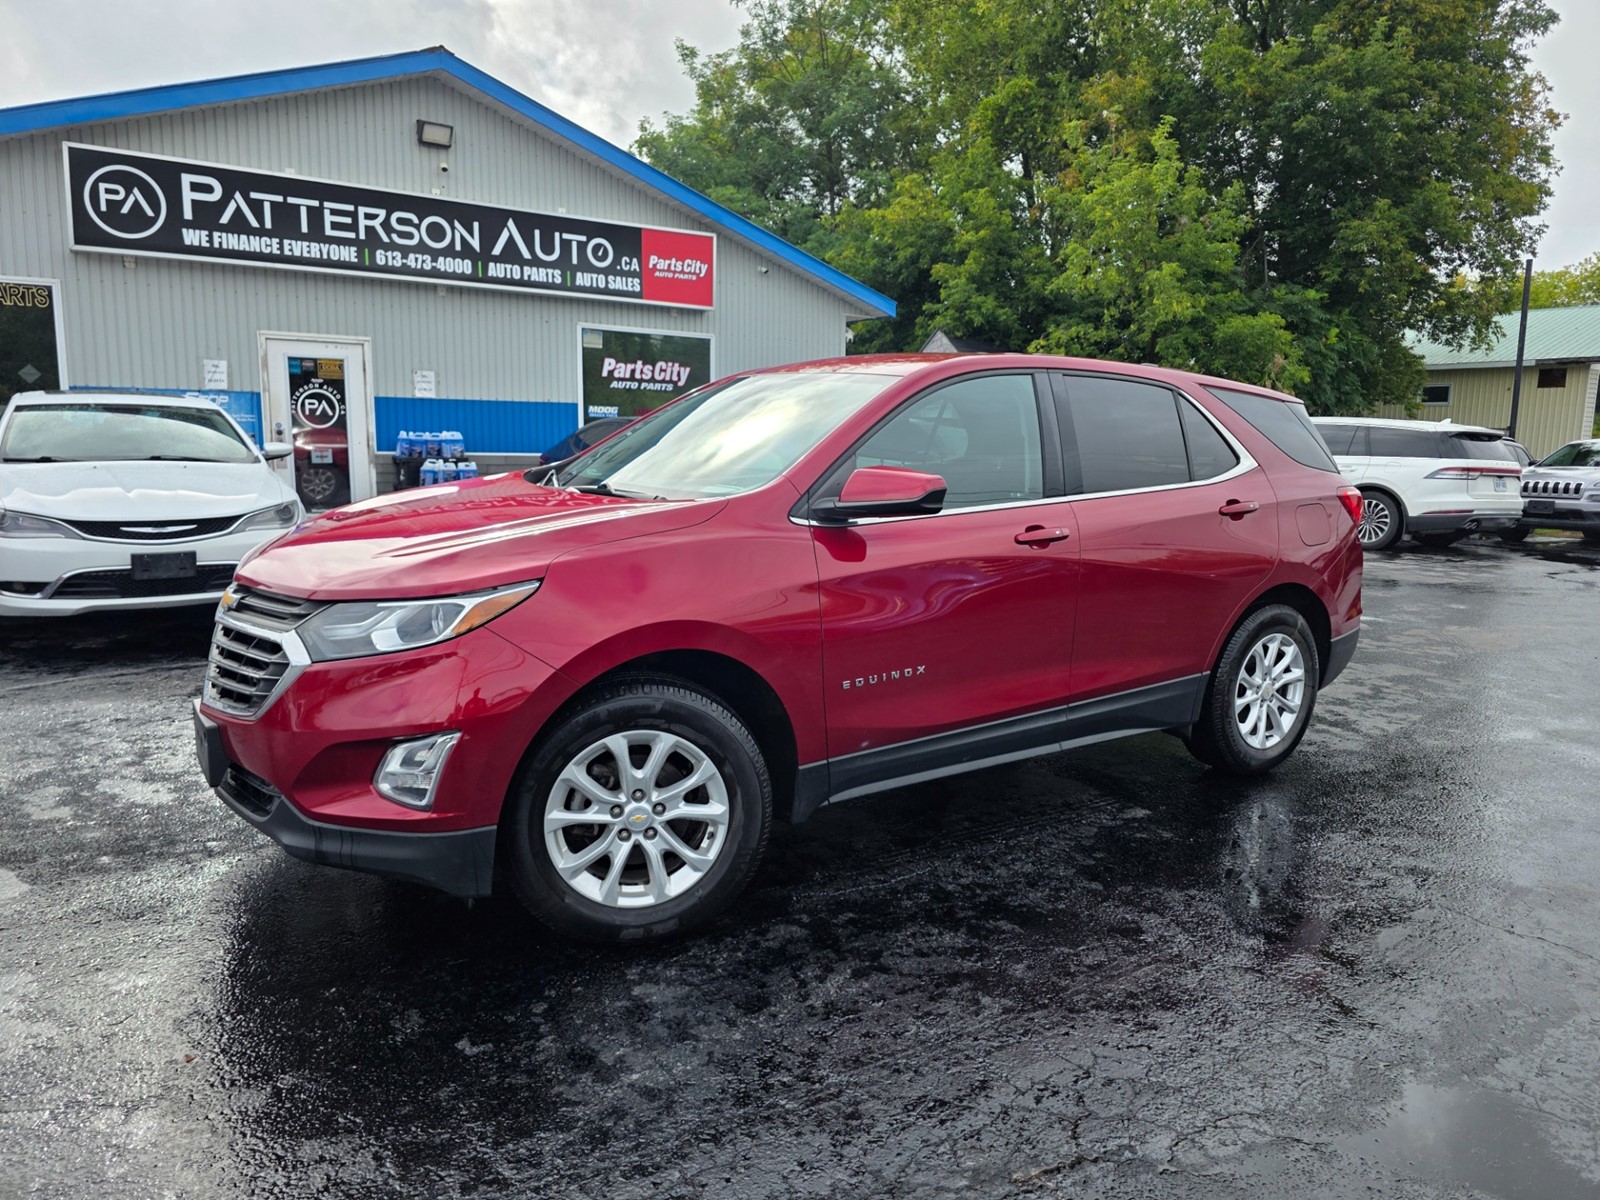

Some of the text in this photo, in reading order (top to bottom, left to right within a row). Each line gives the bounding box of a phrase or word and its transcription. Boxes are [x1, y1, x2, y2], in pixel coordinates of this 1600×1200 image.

[180, 172, 481, 253] PATTERSON
[181, 227, 641, 292] WE FINANCE EVERYONE 613-473-4000 AUTO PARTS AUTO SALES
[654, 270, 697, 281] AUTO PARTS
[290, 383, 320, 414] PATTERSON
[610, 380, 674, 392] AUTO PARTS
[588, 405, 619, 414] MOOG
[842, 664, 926, 690] EQUINOX
